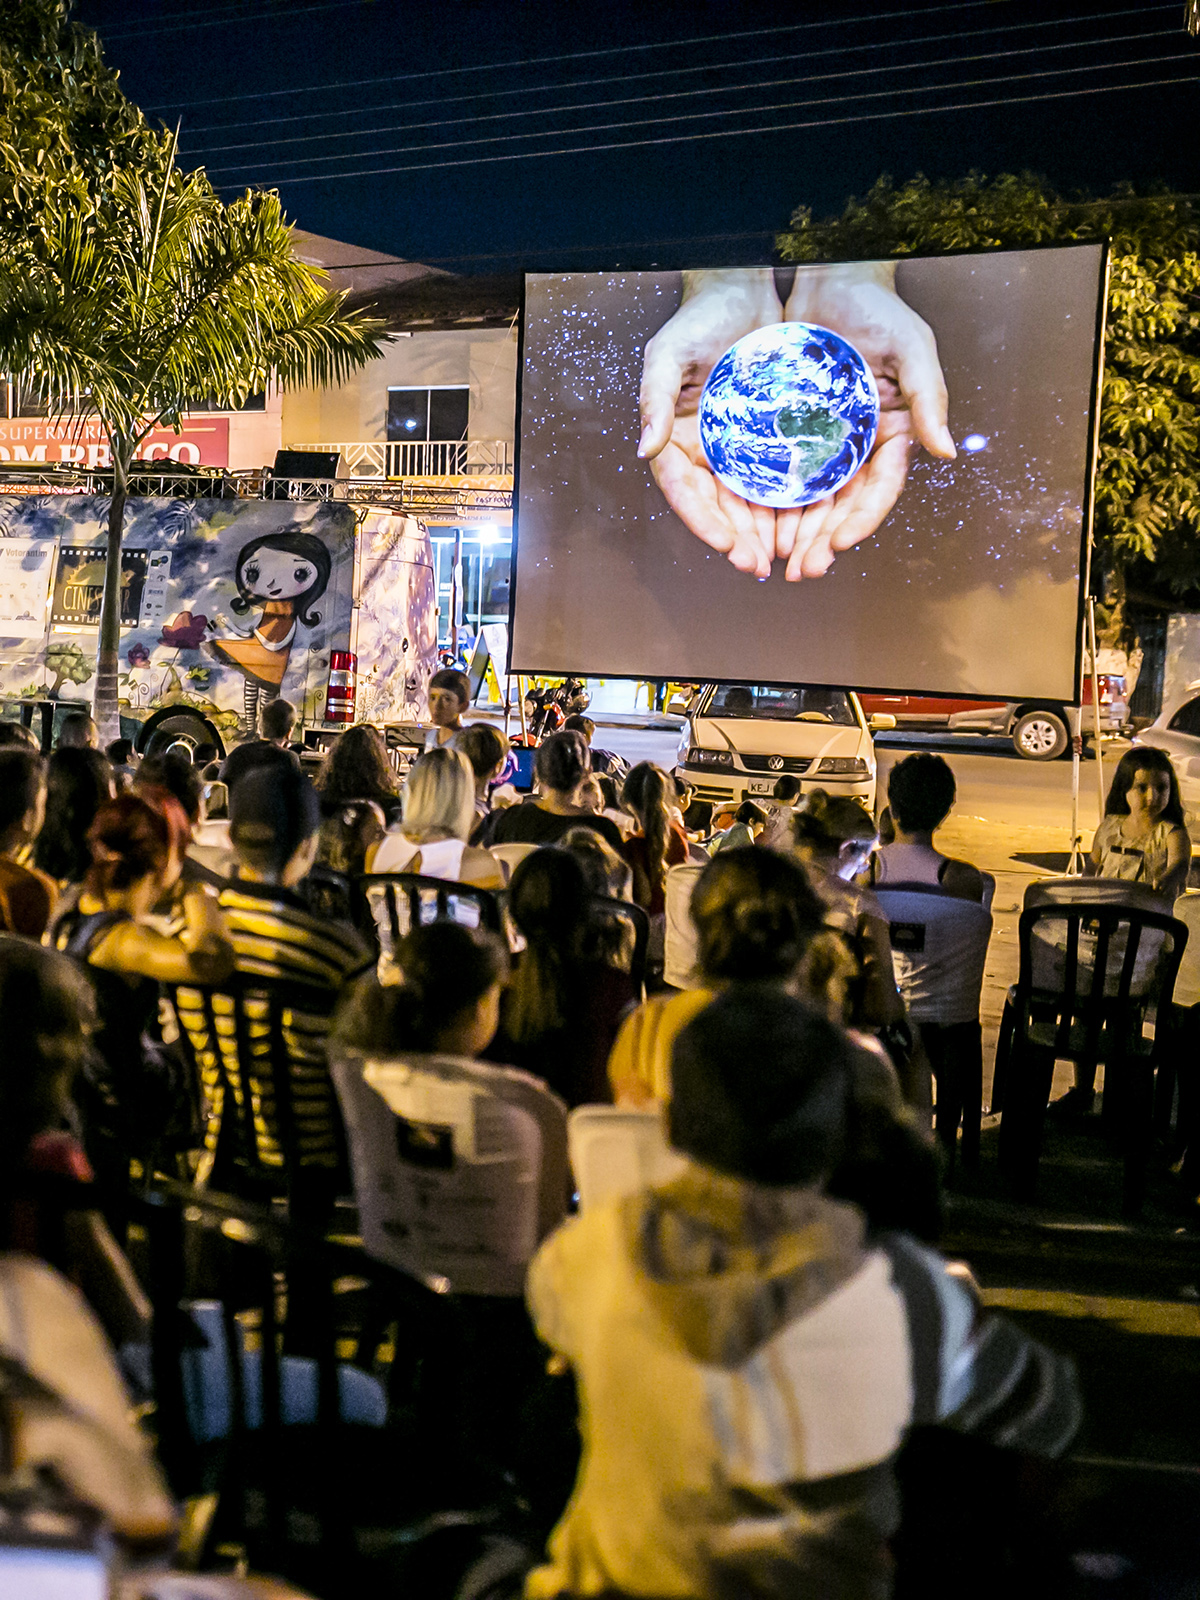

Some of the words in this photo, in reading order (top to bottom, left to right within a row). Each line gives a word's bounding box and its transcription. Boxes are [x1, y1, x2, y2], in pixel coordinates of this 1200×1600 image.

[0, 425, 154, 441] SUPERMERC
[59, 442, 200, 467] PRCO
[5, 548, 48, 558] Votorantim
[63, 586, 130, 614] CINESR
